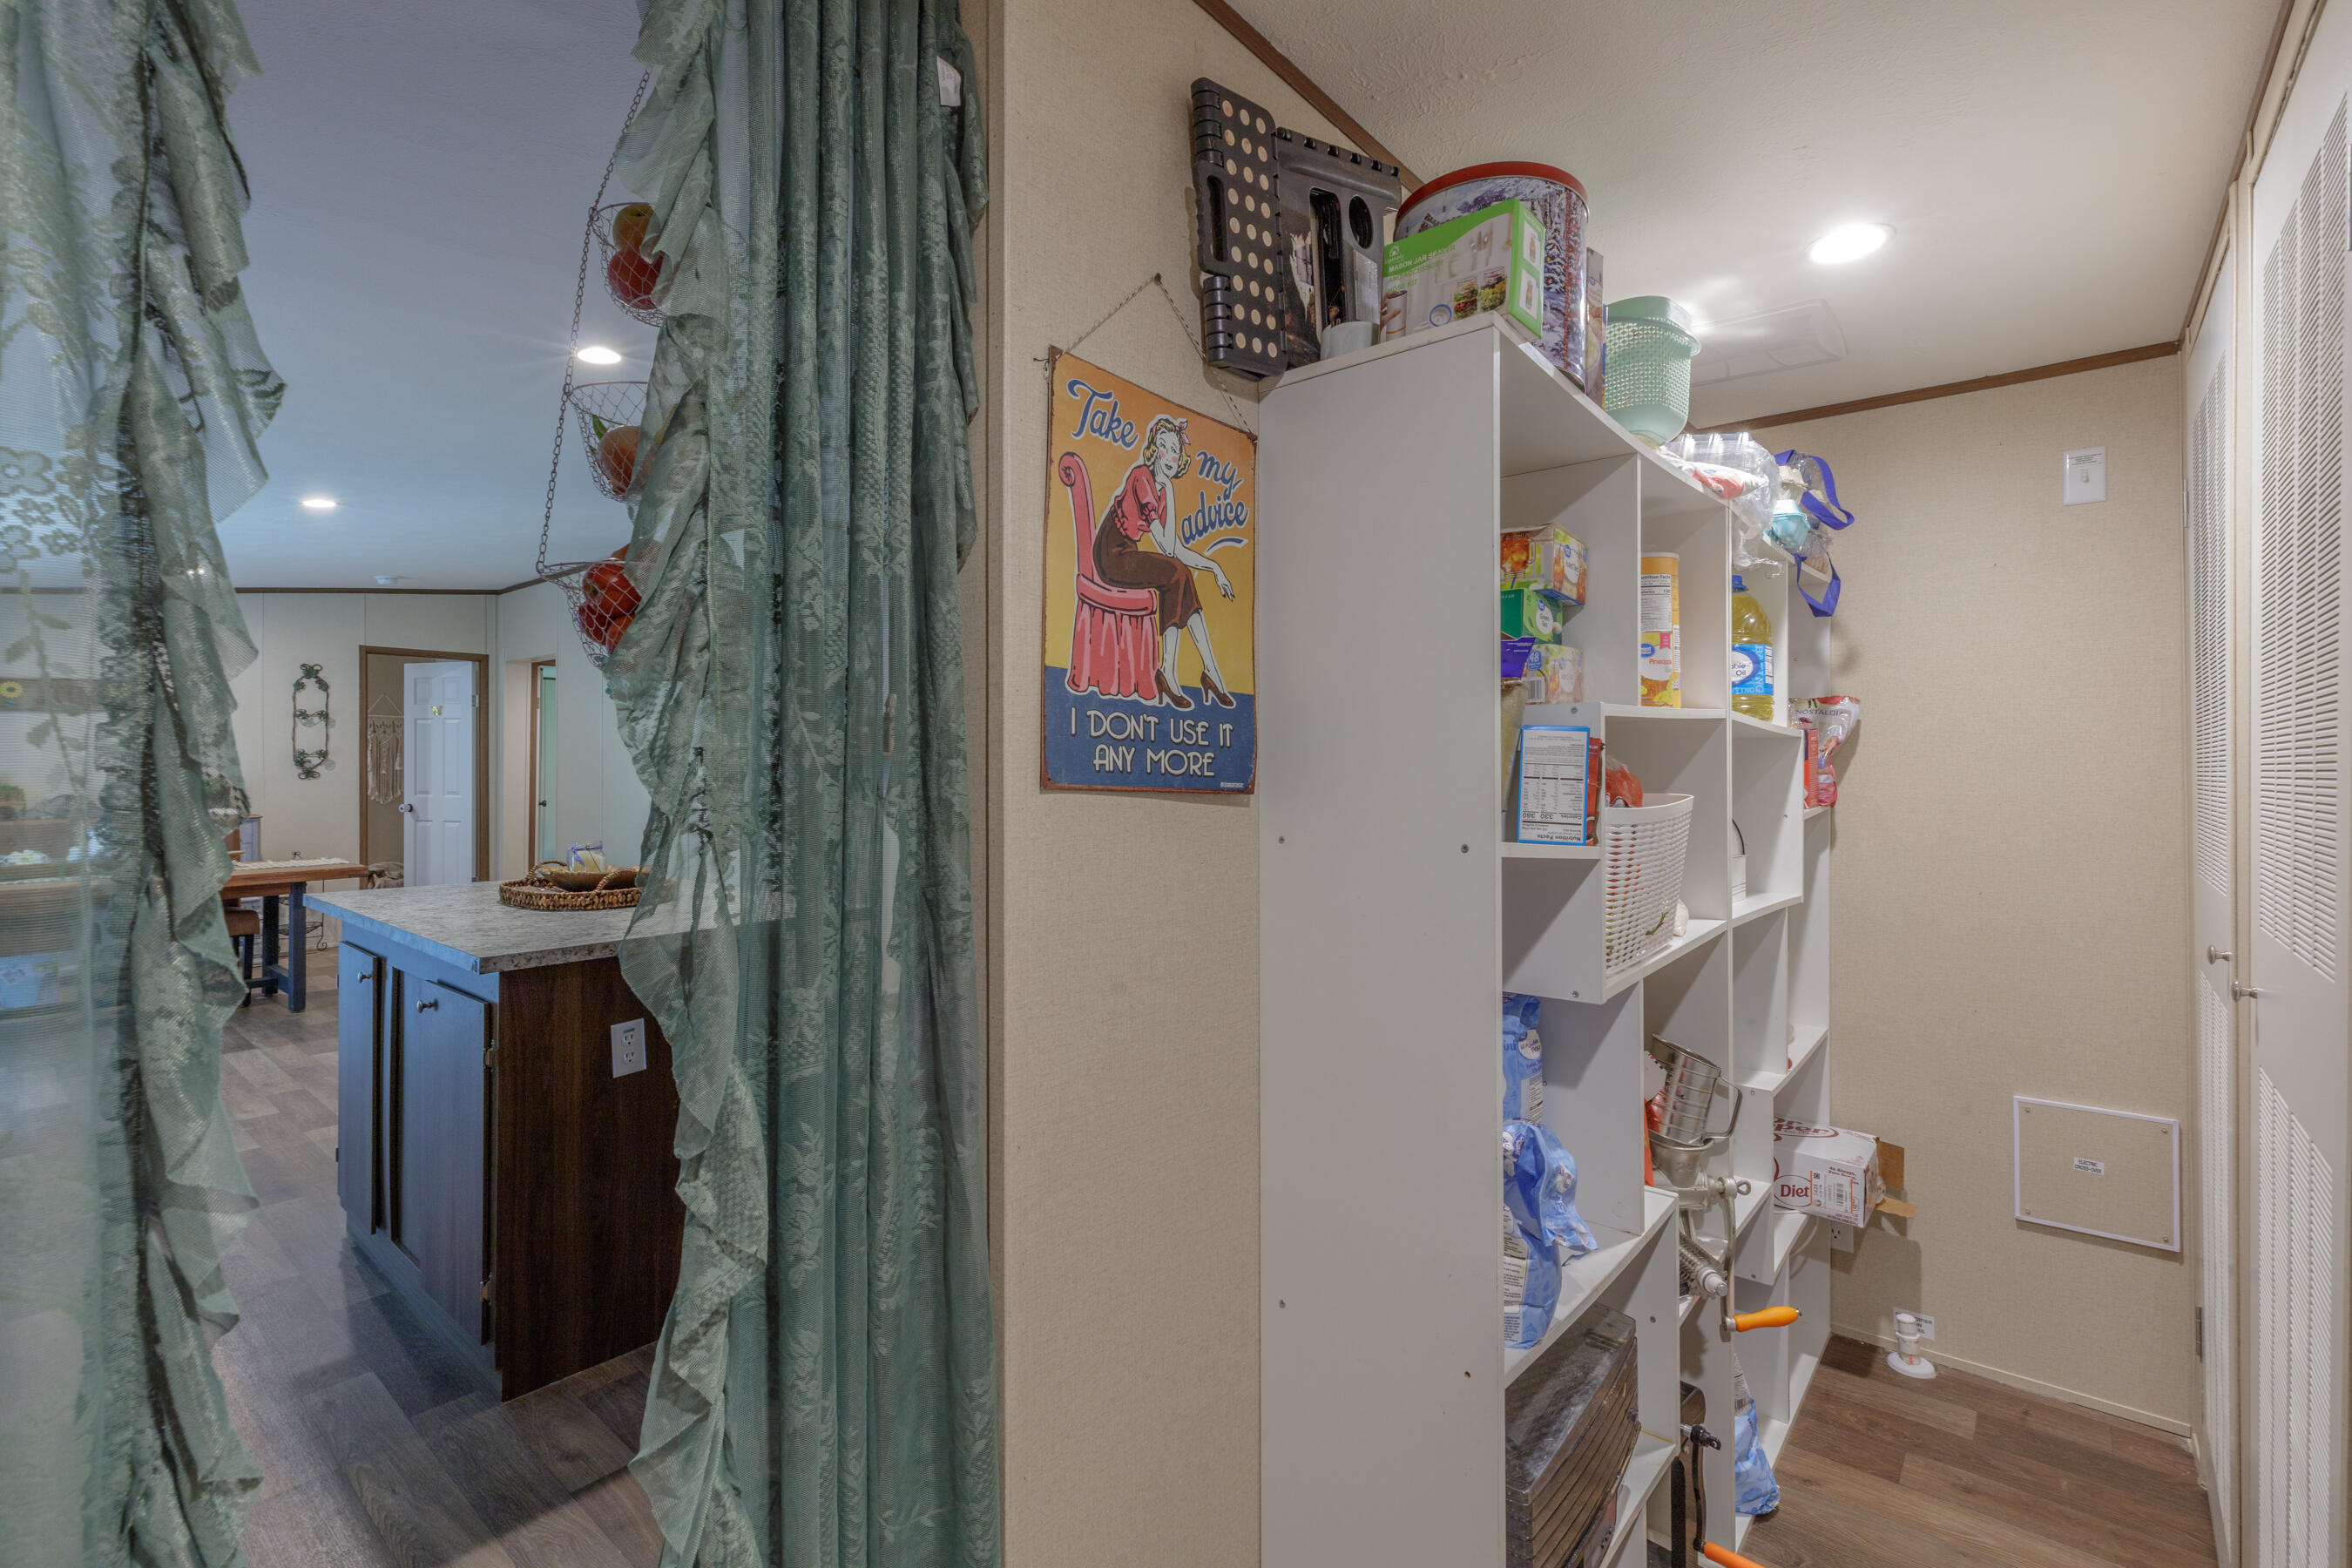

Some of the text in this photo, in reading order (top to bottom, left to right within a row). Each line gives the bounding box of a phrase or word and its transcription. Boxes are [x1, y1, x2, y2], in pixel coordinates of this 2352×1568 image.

[1389, 260, 1412, 272] MASON
[1414, 253, 1427, 264] JAR
[1067, 378, 1138, 449] Take
[1196, 449, 1243, 500] my
[1180, 490, 1250, 546] advice
[1529, 652, 1539, 662] 48
[1070, 706, 1233, 747] I DON'T USE IT
[1093, 743, 1215, 777] ANY MORE
[1781, 1185, 1809, 1198] Diet
